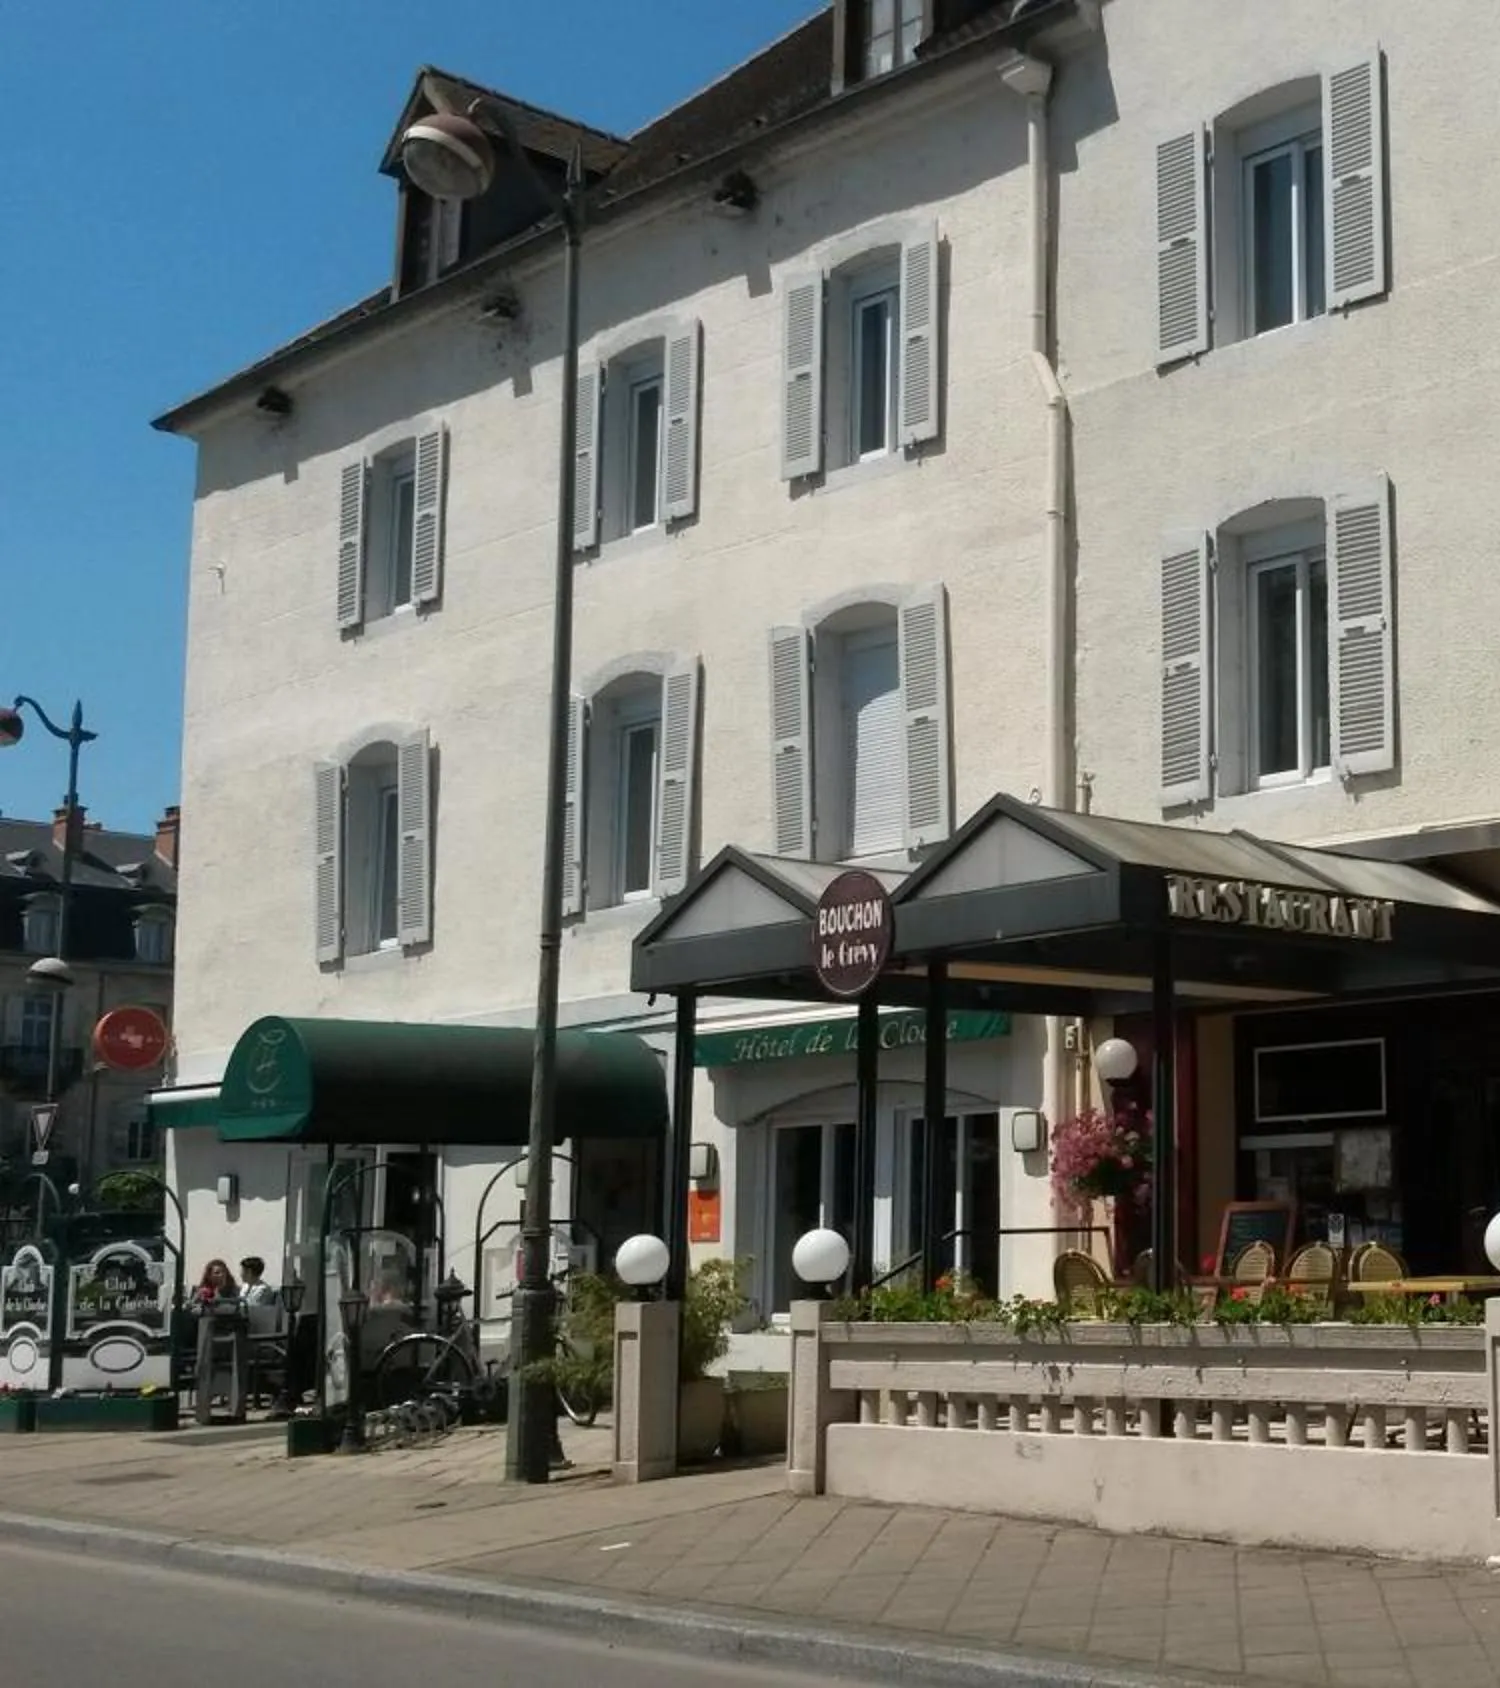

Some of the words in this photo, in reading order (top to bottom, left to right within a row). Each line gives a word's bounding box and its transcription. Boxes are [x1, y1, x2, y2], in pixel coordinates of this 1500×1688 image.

[819, 899, 883, 936] BOUCHON
[1164, 875, 1395, 942] RESTAURANT
[821, 943, 835, 969] le
[731, 1028, 801, 1062] Hôtel
[805, 1025, 833, 1054] de
[104, 1275, 137, 1291] Club
